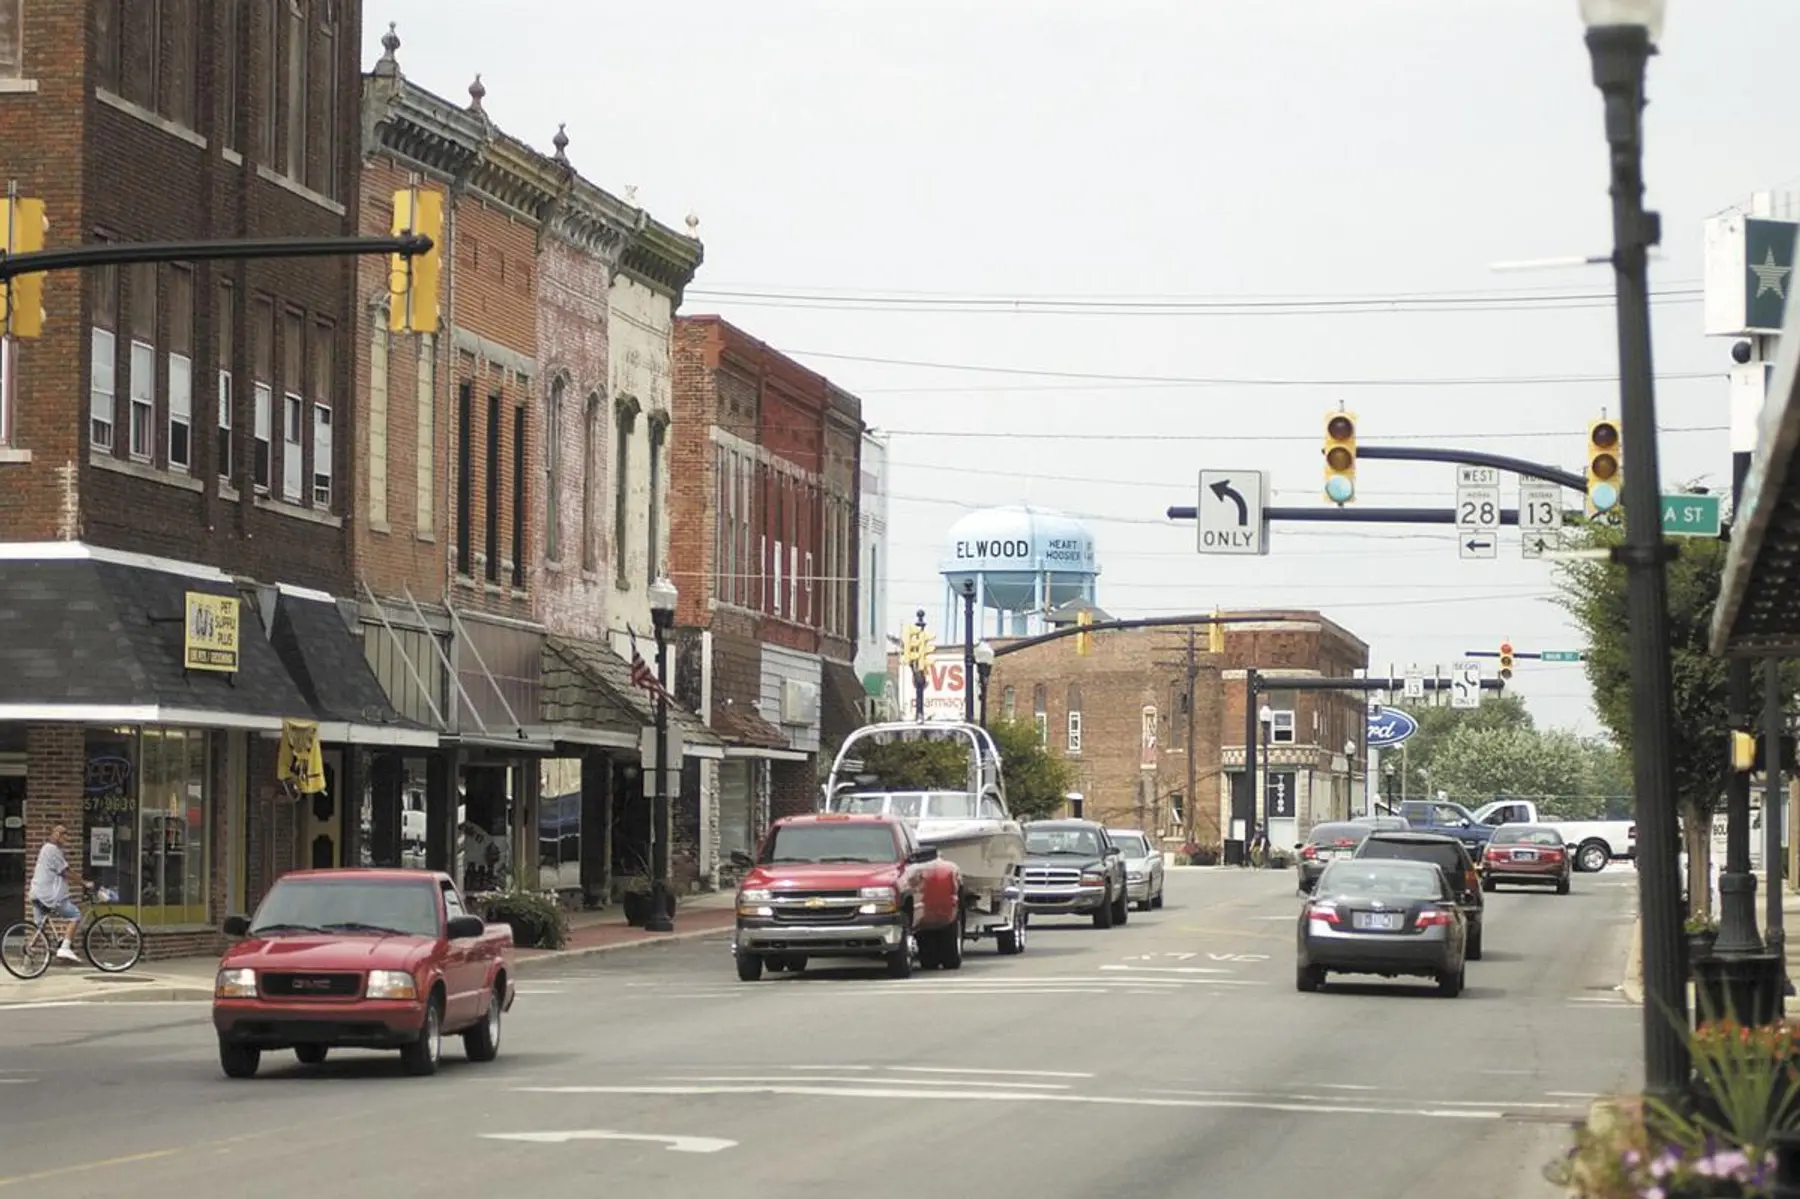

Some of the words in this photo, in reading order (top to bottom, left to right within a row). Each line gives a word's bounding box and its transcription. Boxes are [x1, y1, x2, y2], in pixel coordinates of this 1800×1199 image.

[1463, 470, 1494, 482] WEST
[1461, 502, 1495, 524] 28
[1528, 502, 1553, 525] 13
[1663, 506, 1677, 522] A
[1050, 540, 1078, 550] HEART
[1204, 530, 1253, 546] ONLY
[957, 540, 1029, 558] ELWOOD
[221, 601, 232, 615] PET
[914, 664, 965, 692] VS
[910, 696, 966, 712] parmacy
